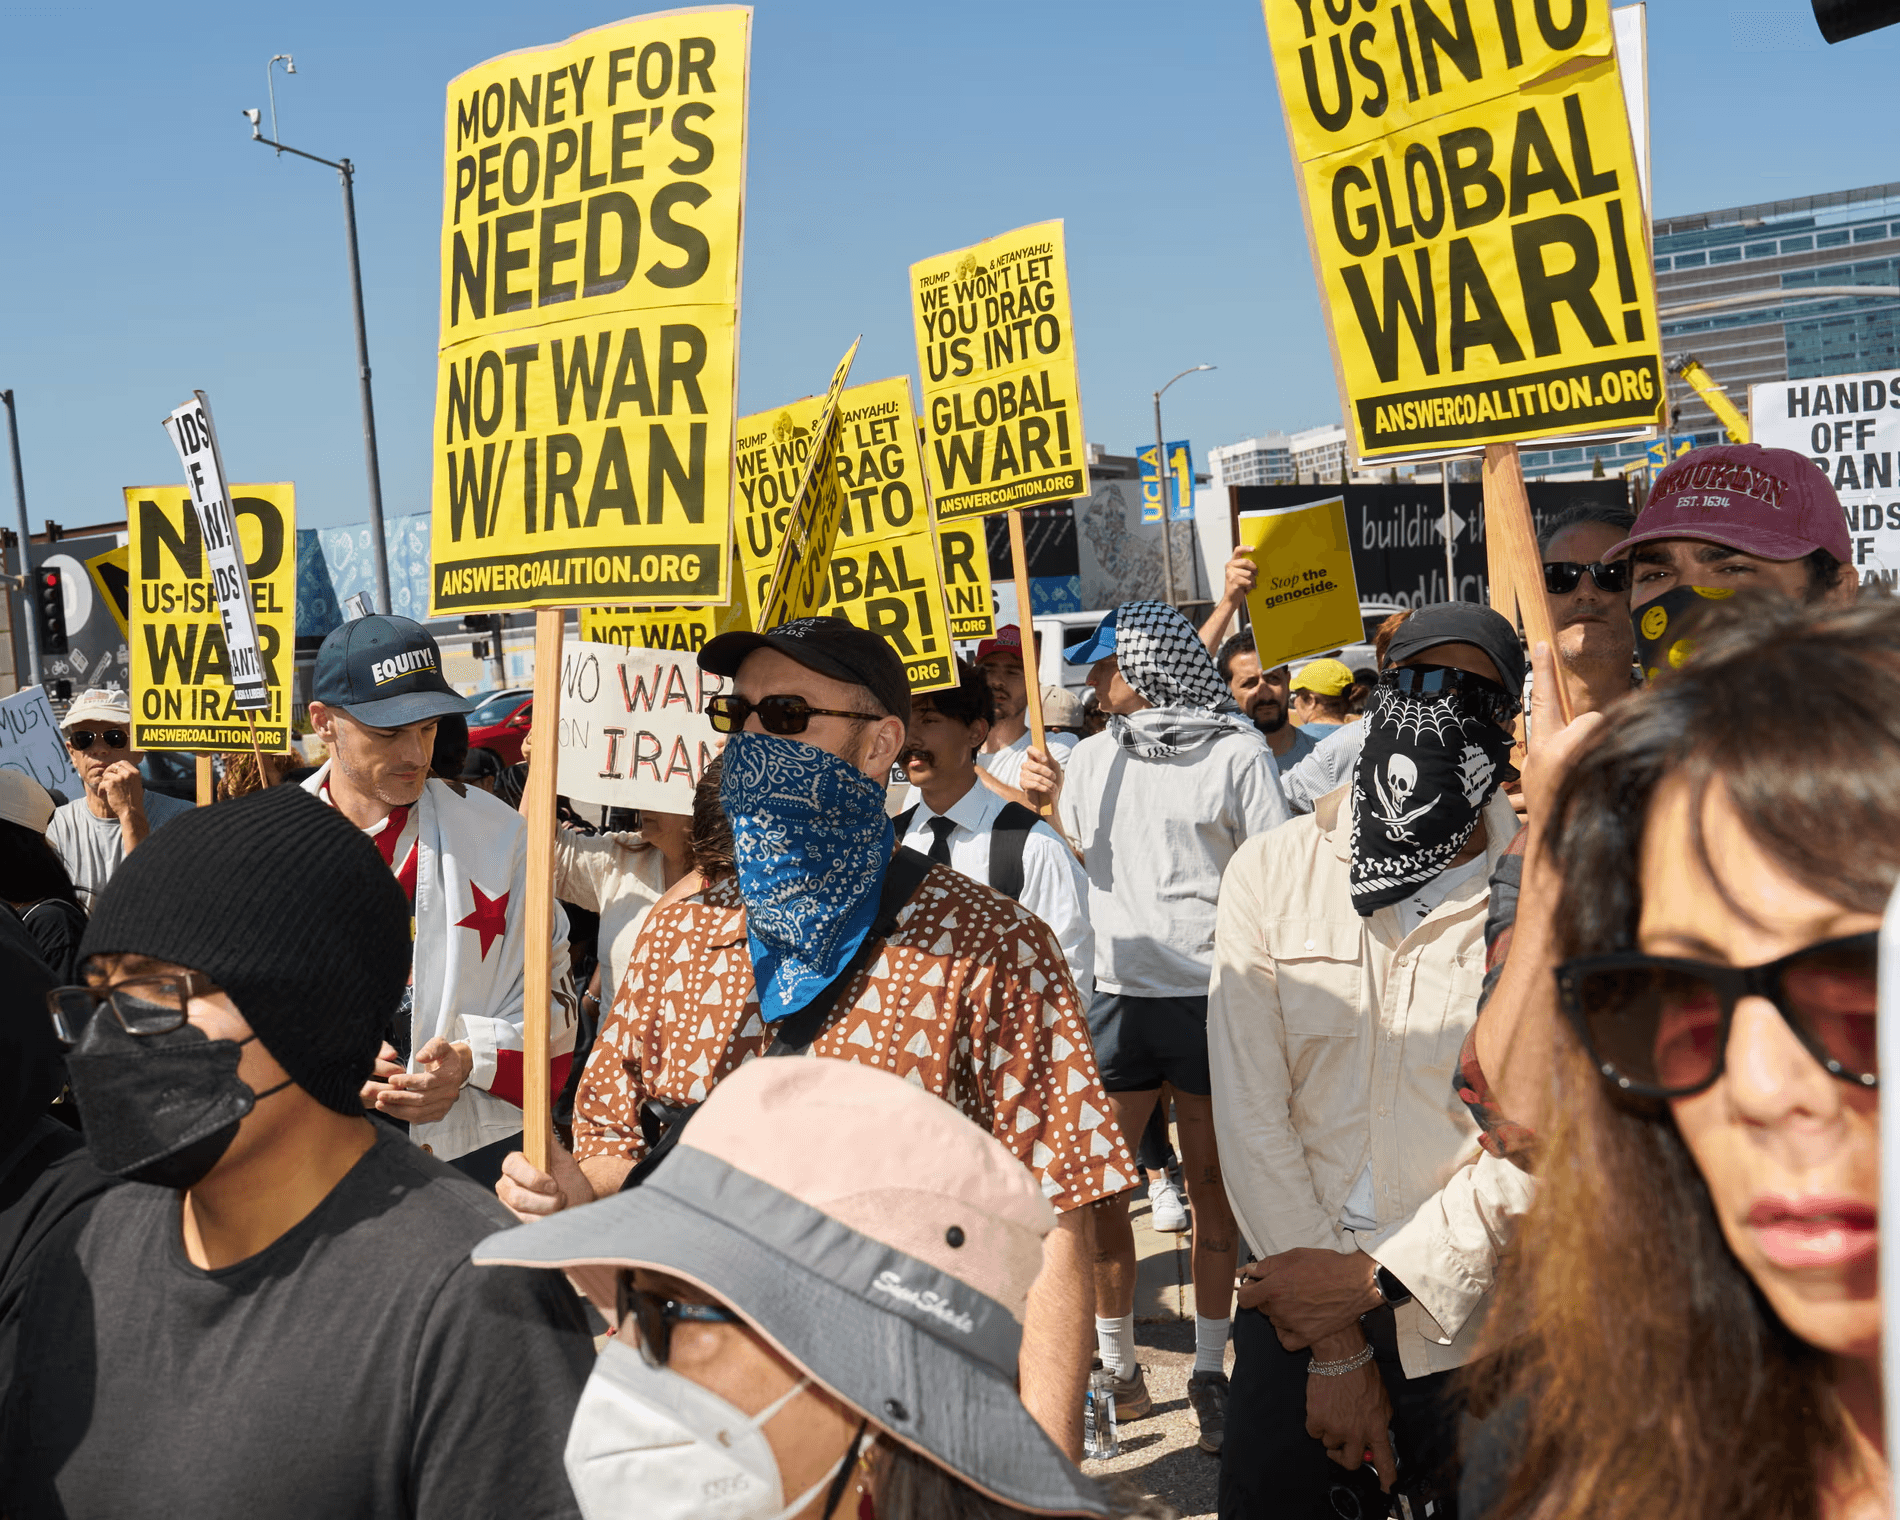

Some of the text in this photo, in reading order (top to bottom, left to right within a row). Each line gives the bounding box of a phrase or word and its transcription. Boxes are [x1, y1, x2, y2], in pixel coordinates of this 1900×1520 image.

[457, 36, 717, 153] MONEY FOR
[1298, 21, 1388, 132] US
[454, 101, 715, 226] PEOPLE'S
[1331, 93, 1619, 257] GLOBAL
[451, 181, 713, 328] NEEDS
[920, 242, 1053, 289] TRUMP & NETANYAHU:
[920, 255, 1053, 313] WE WON'T LET
[922, 280, 1055, 343] YOU DRAG
[1340, 198, 1646, 383] WAR!
[926, 313, 1061, 382] US INTO
[447, 323, 709, 446] NOT WAR
[932, 369, 1066, 436] GLOBAL
[1374, 367, 1654, 435] ANSWERCOALITION.ORG
[736, 449, 769, 479] WE
[854, 415, 900, 449] LET
[933, 410, 1073, 491] WAR!
[1811, 418, 1877, 454] OFF
[447, 440, 513, 543] W/
[524, 422, 708, 535] IRAN
[739, 443, 905, 513] YOU RAG
[940, 475, 1075, 514] ANSWERCOALITION.ORG
[1140, 447, 1163, 521] UCLA
[1676, 495, 1731, 508] EST. 1634
[138, 496, 285, 581] NO
[141, 582, 283, 614] US-ISEL
[441, 553, 701, 597] ANSWERCOALITION.ORG
[1265, 580, 1338, 609] genocide.
[1270, 568, 1327, 591] Stop the
[143, 623, 281, 687] WAR
[371, 647, 436, 684] EQUITY!
[640, 622, 708, 652] WAR
[142, 688, 182, 721] ON
[560, 652, 600, 703] NO
[0, 696, 50, 745] MUST
[558, 717, 590, 749] ON
